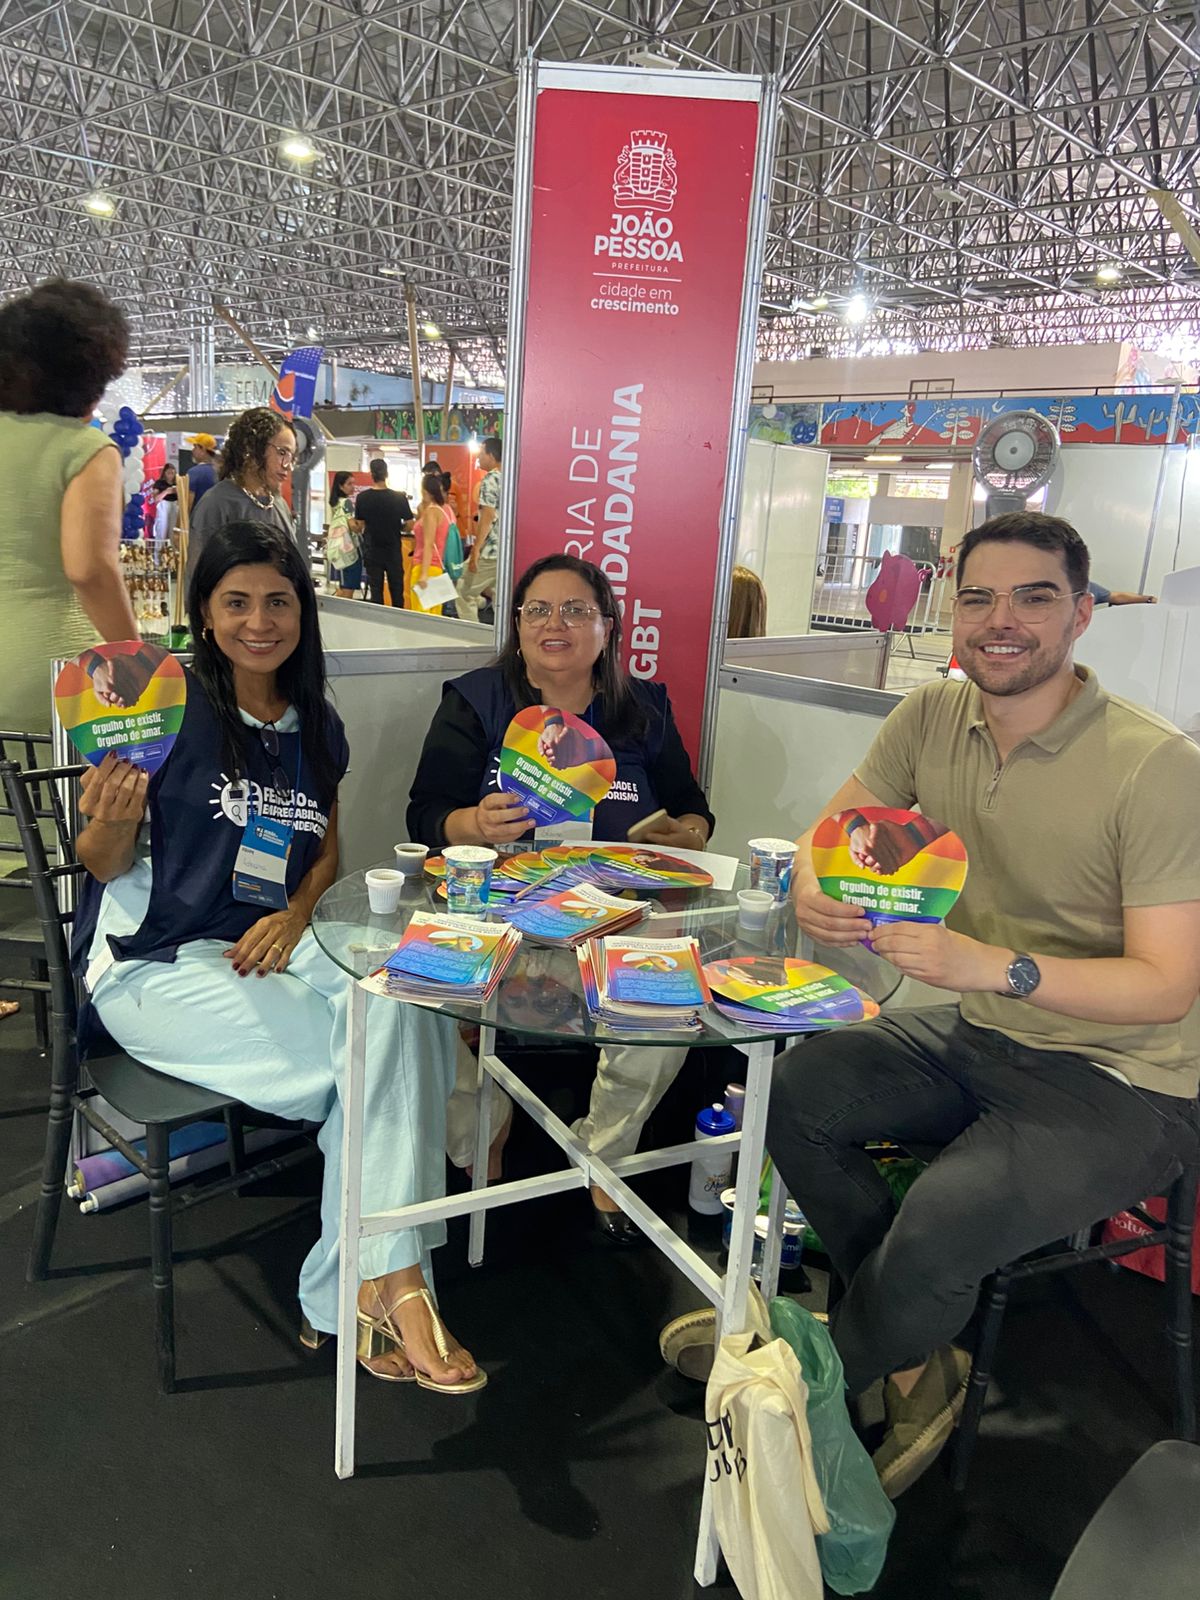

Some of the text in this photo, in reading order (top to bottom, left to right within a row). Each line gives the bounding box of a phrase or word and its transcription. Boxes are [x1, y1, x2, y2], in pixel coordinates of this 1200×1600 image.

[610, 210, 673, 239] JOÃO
[594, 235, 684, 262] PESSOA
[611, 262, 669, 273] PREFEITURA
[599, 281, 672, 300] cidade em
[590, 297, 679, 316] crescimento
[569, 425, 602, 483] DE
[92, 712, 164, 735] Orgulho de existir.
[96, 726, 164, 748] Orgulho de amar.
[511, 767, 538, 789] Orgulho
[537, 784, 549, 795] de
[546, 790, 565, 807] amar.
[515, 757, 573, 799] Orgulho de existir.
[839, 880, 925, 901] Orgulho de existir.
[842, 894, 921, 914] Orgulho de amar.
